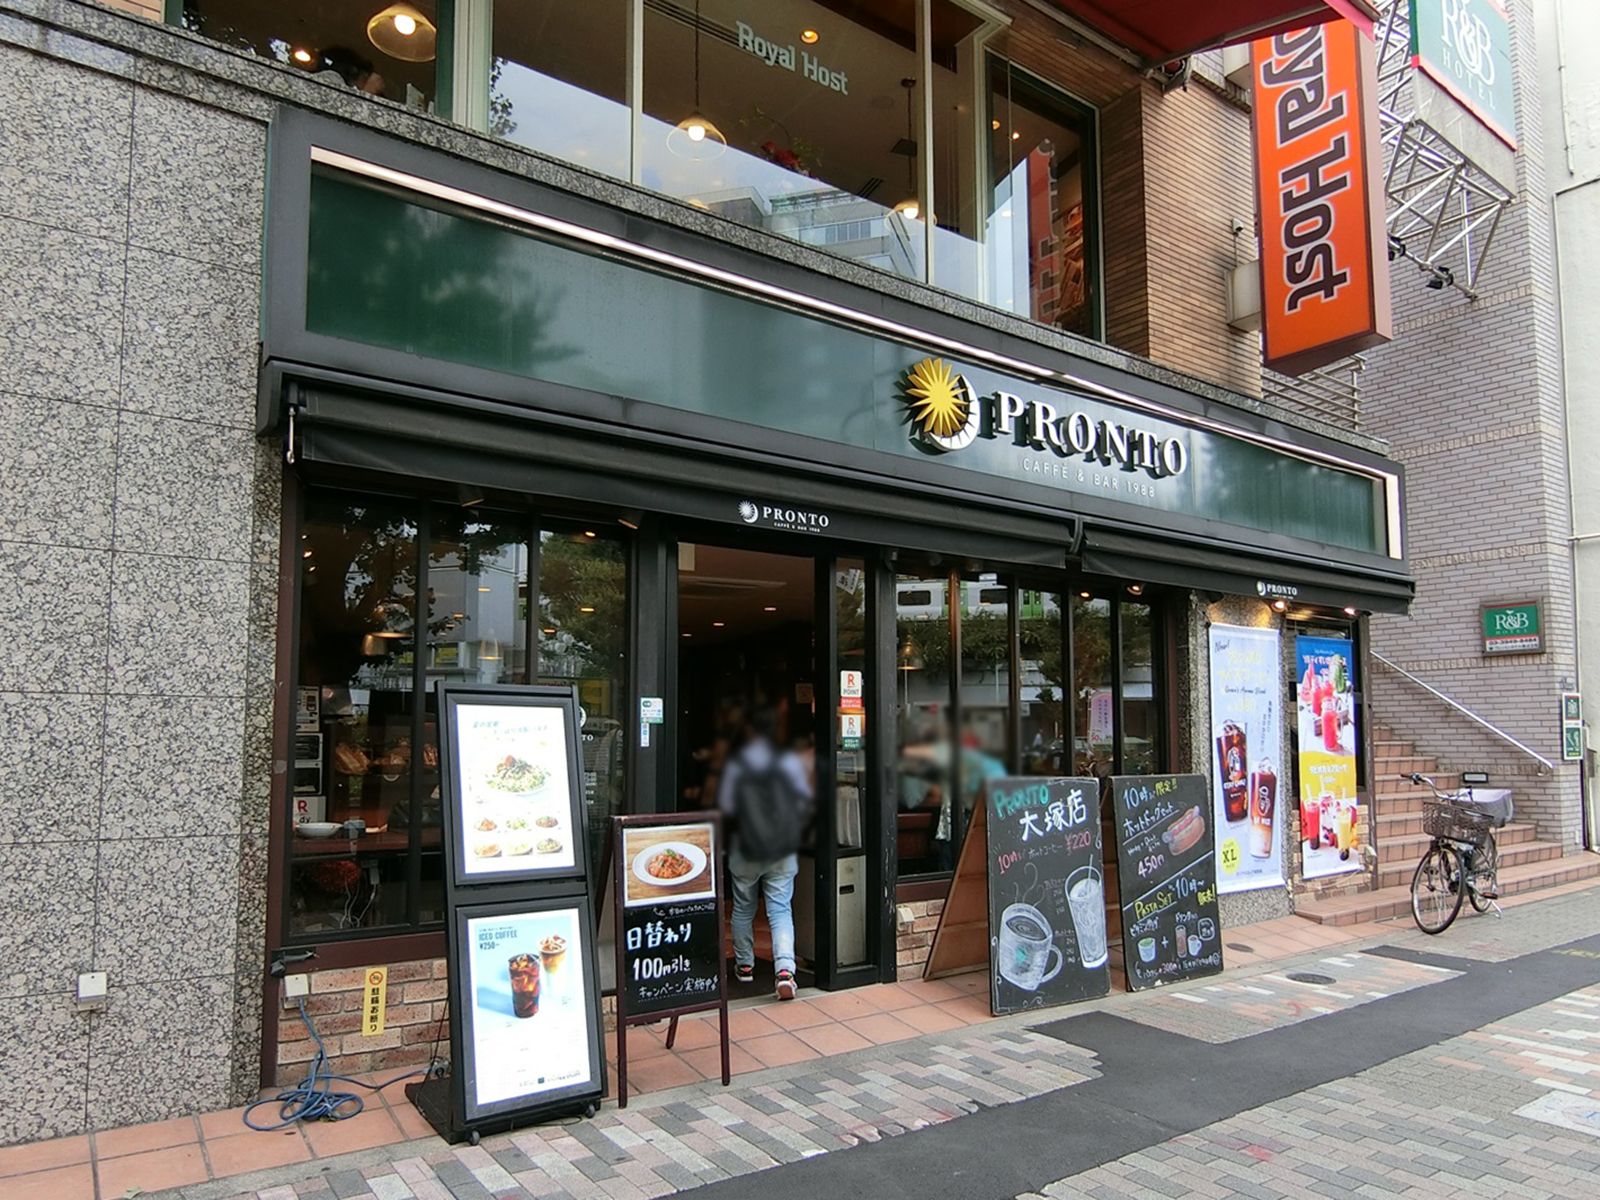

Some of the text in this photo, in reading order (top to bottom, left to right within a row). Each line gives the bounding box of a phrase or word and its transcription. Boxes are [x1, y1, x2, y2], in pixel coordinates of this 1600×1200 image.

[736, 20, 848, 95] Royal Host
[1443, 48, 1496, 111] HOTEL
[1260, 24, 1351, 315] oyal Host
[995, 390, 1188, 476] PRONTO
[1022, 457, 1156, 498] CAFFÈ & BAR 1988
[762, 506, 830, 528] PRONTO
[1266, 583, 1298, 596] PRONTO
[1495, 612, 1529, 631] R&B
[847, 673, 855, 687] R
[848, 717, 854, 727] R
[1019, 788, 1087, 842] 大塚店
[1222, 849, 1237, 864] XL
[479, 929, 518, 941] ICED COFFEE
[626, 920, 692, 951] 日替わり
[633, 954, 692, 981] 100円引き
